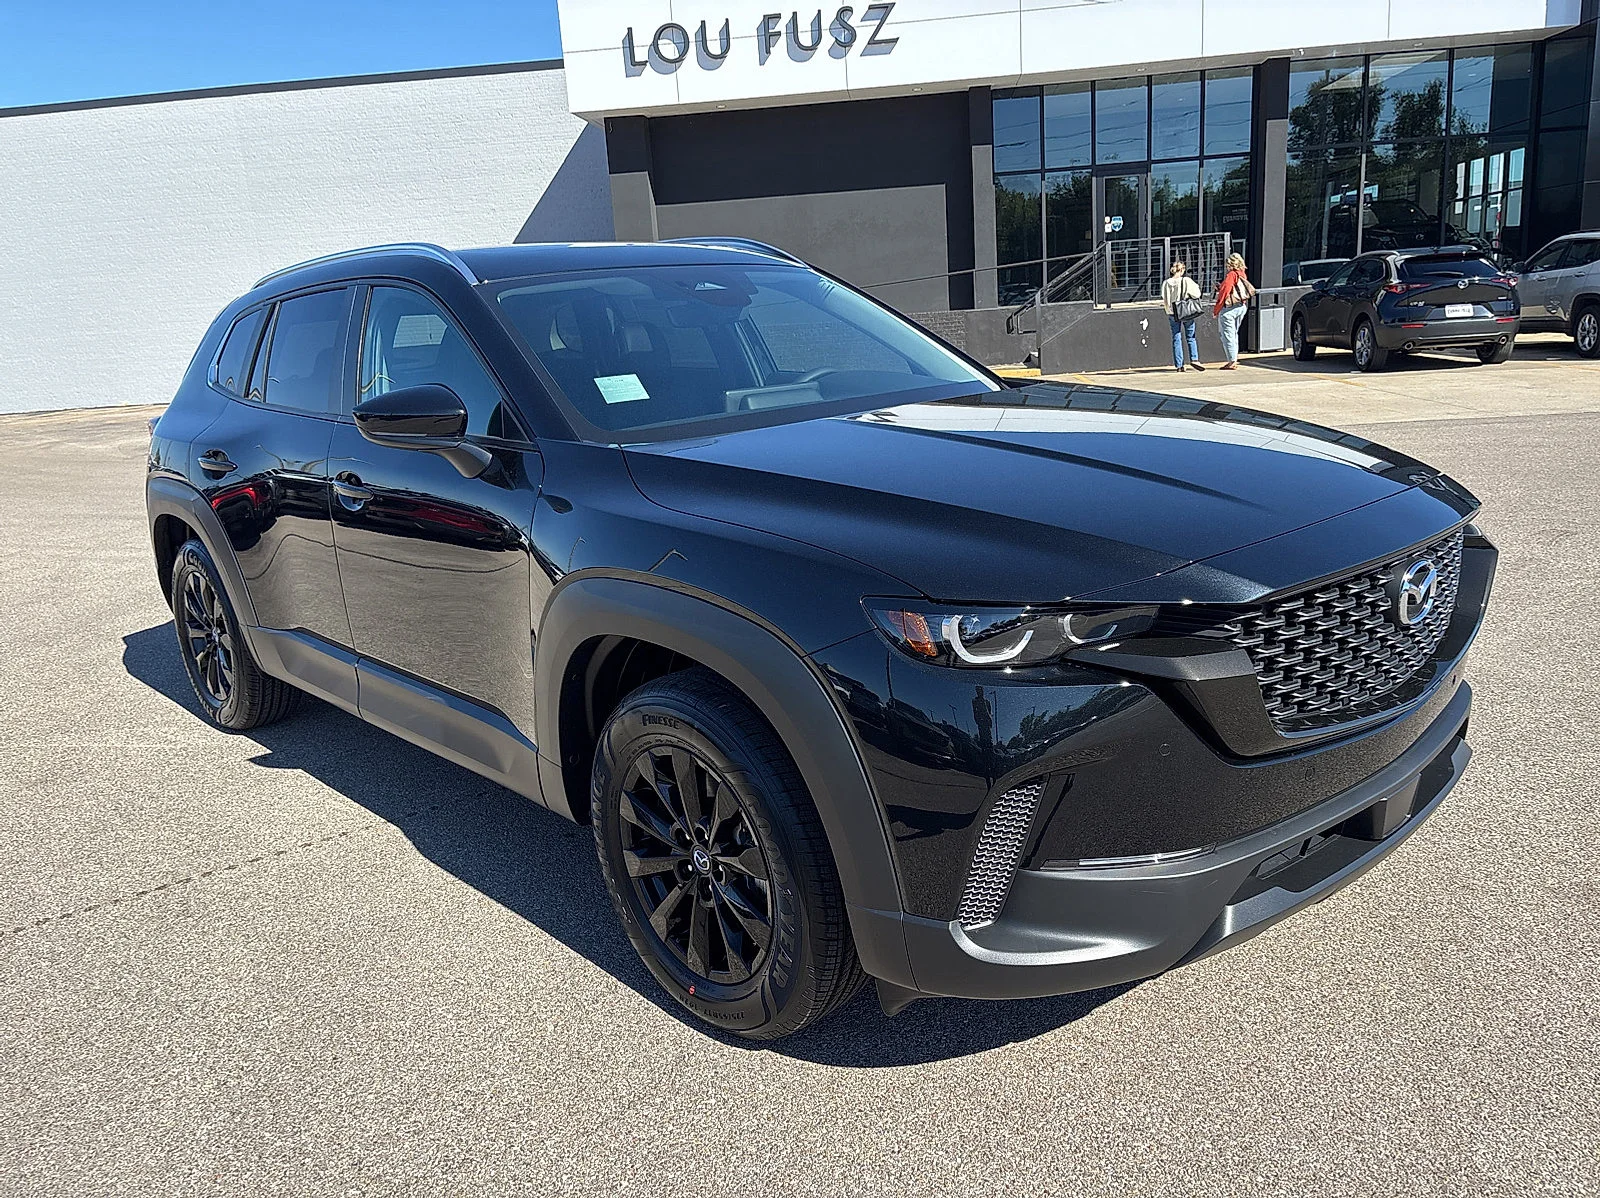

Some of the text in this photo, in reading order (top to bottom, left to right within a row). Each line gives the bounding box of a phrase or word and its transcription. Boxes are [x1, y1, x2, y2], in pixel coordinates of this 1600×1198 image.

[625, 2, 900, 67] LOU FUSZ
[641, 713, 681, 730] FINESSE
[746, 793, 798, 989] GOODYEAR
